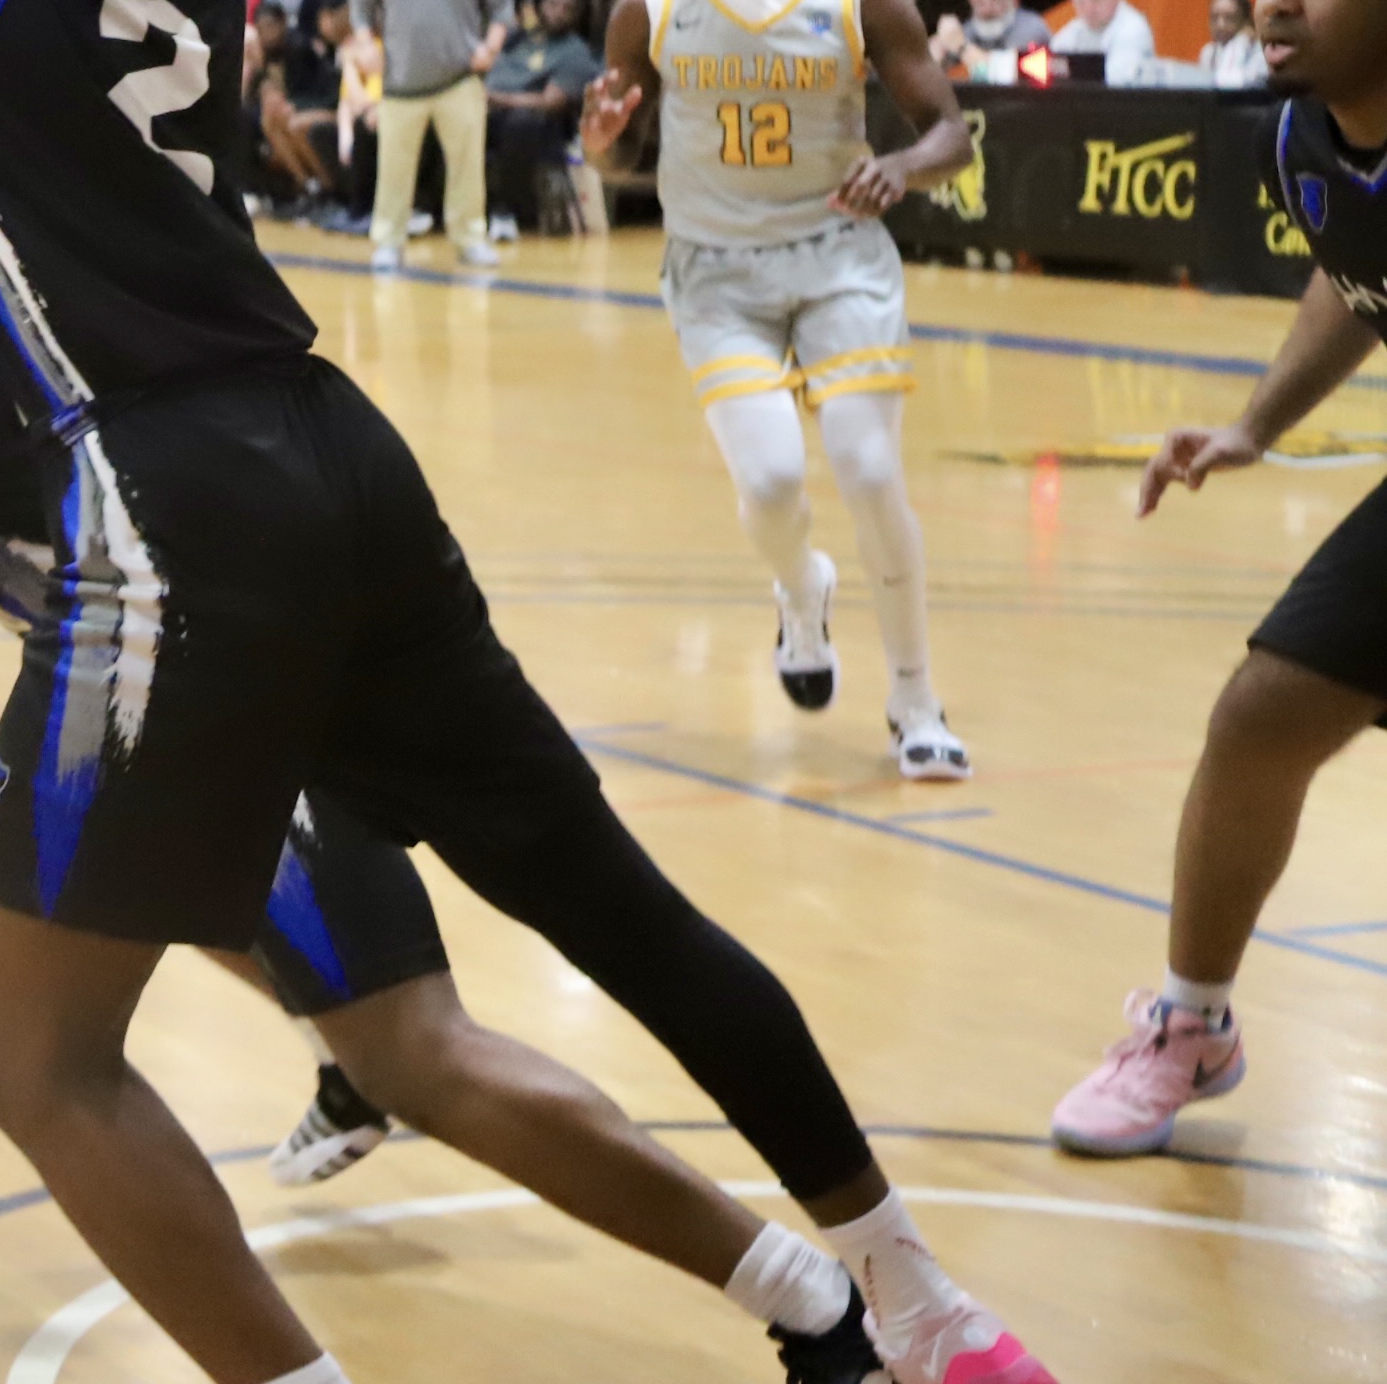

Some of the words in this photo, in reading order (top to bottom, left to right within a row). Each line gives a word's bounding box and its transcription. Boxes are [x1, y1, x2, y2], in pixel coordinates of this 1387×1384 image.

[673, 55, 838, 91] TROJANS
[717, 102, 792, 168] 12
[1078, 132, 1196, 220] FTCC
